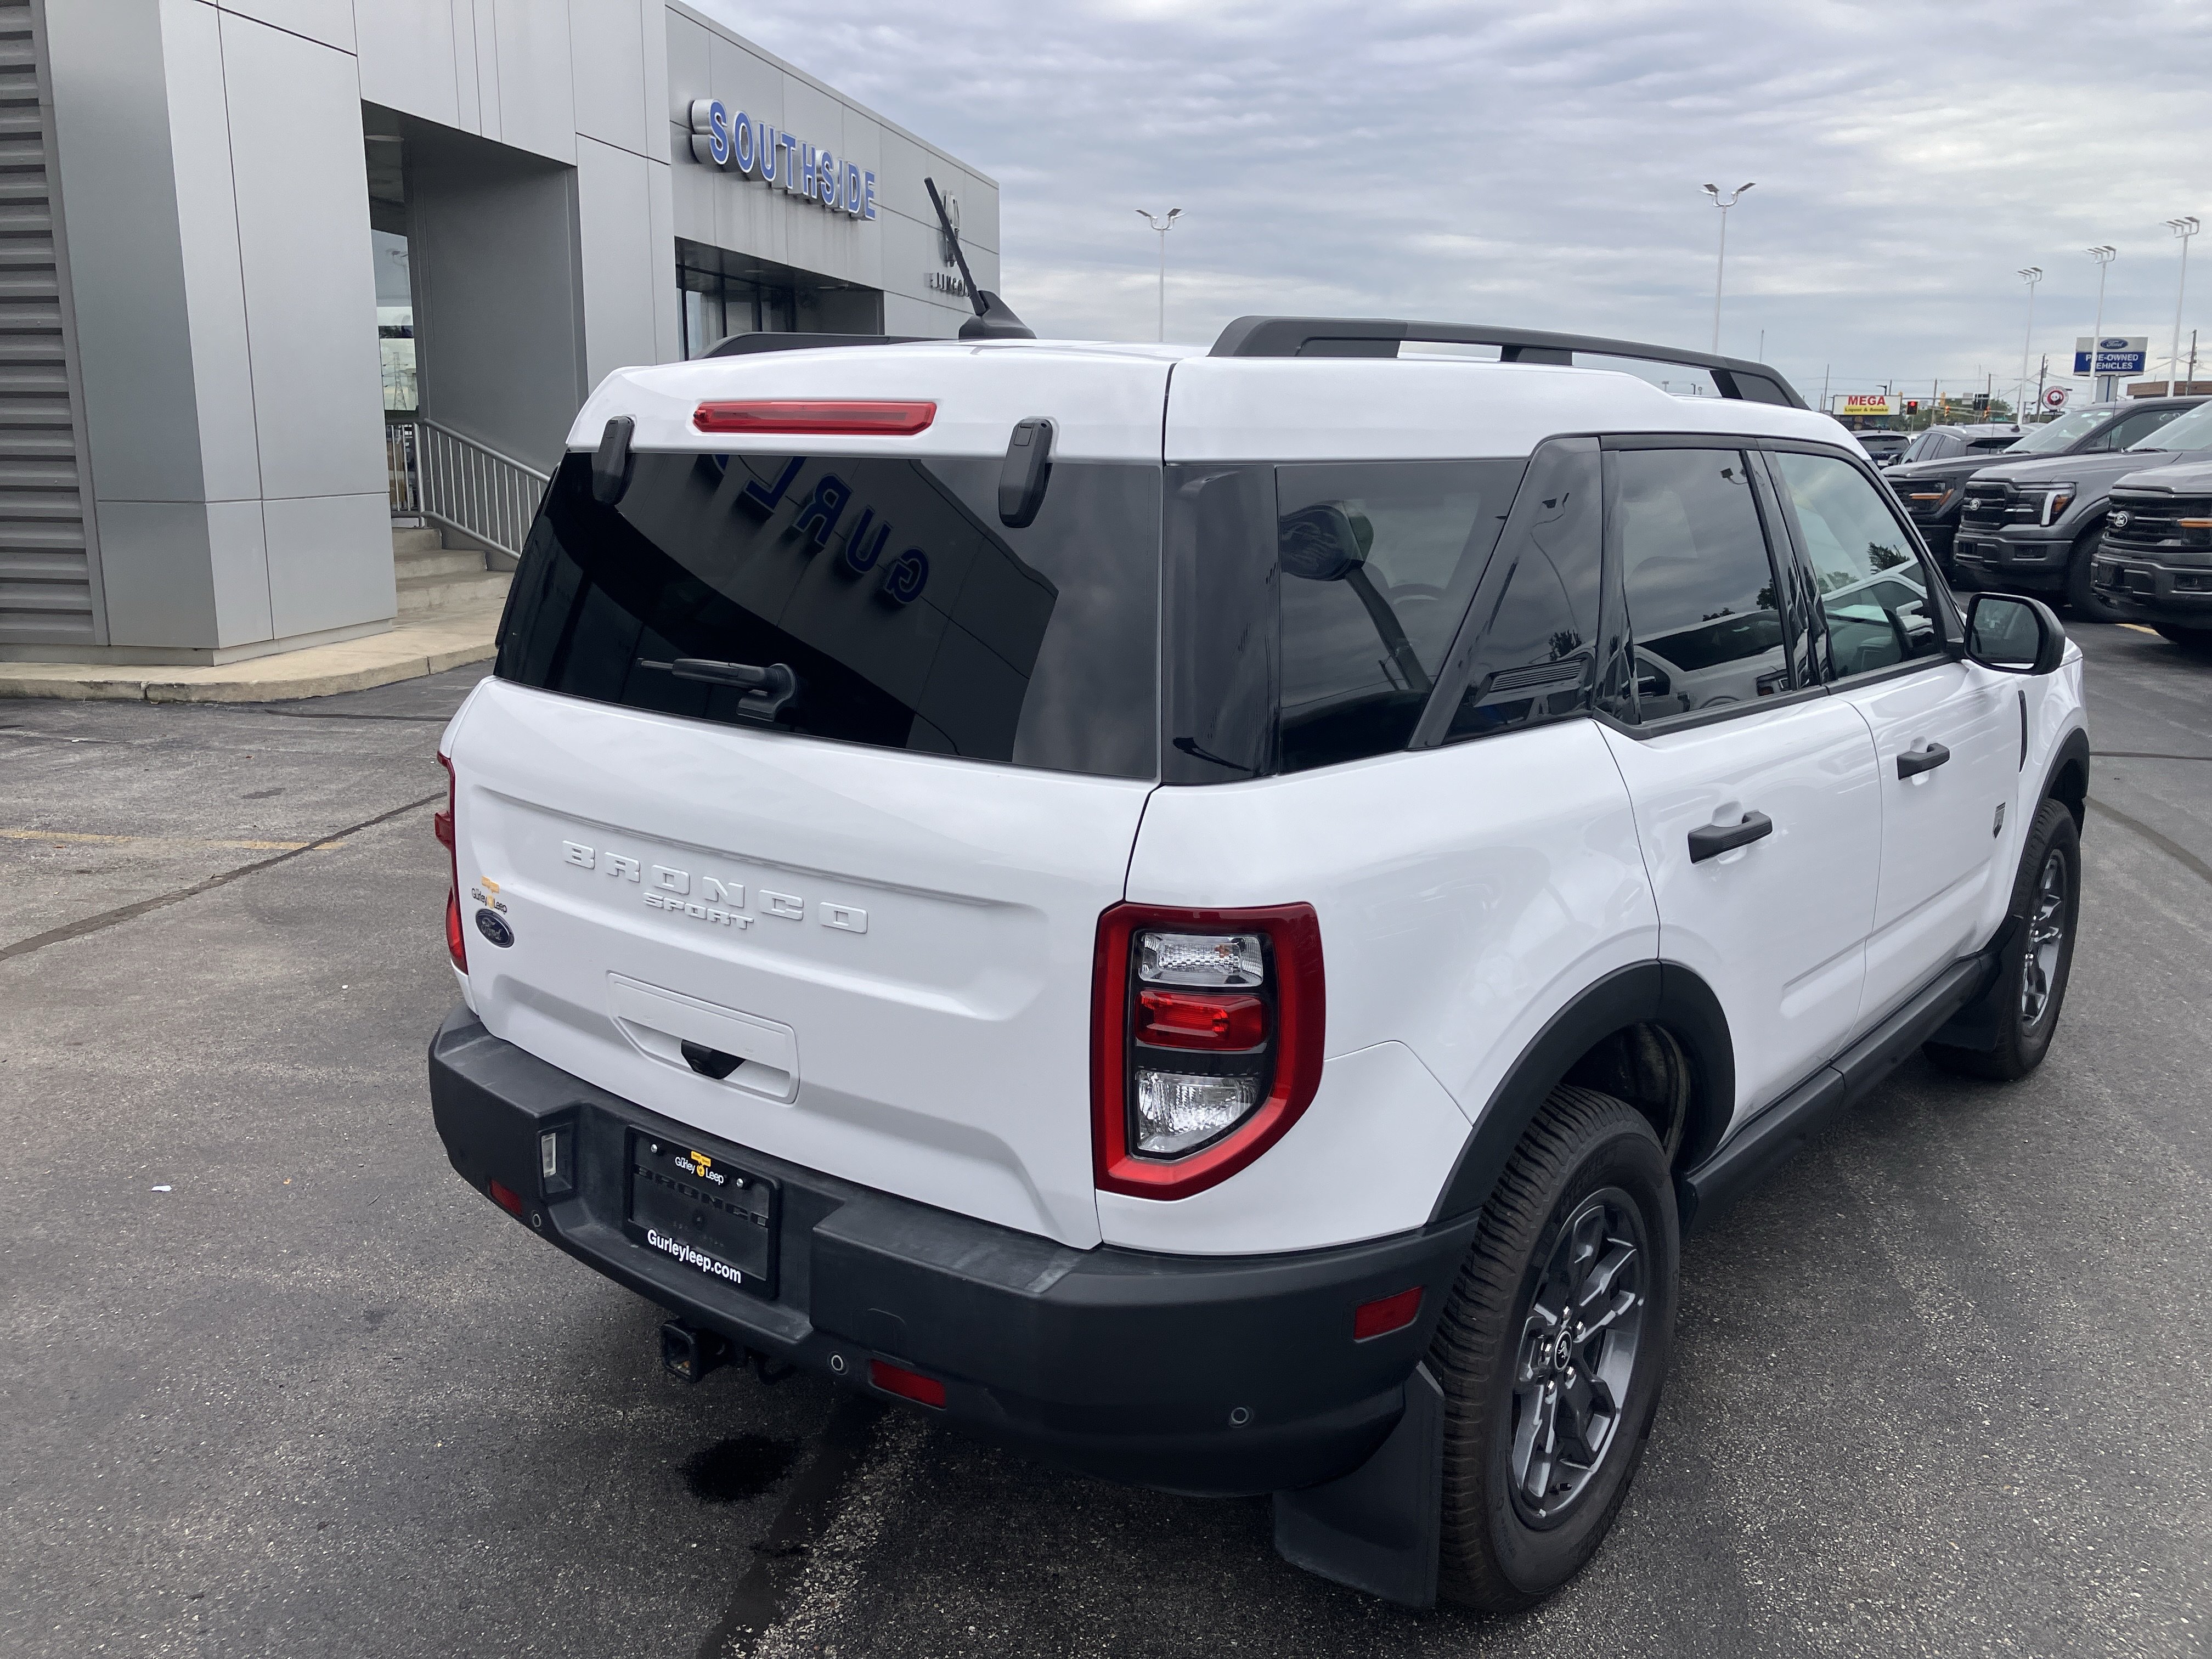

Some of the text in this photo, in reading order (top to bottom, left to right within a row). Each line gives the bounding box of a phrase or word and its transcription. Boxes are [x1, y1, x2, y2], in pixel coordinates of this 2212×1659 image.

[707, 98, 876, 221] SOUTHSIDE
[1847, 394, 1886, 406] MEGA
[562, 839, 868, 934] BRONCO
[493, 898, 507, 915] Leep
[642, 891, 755, 930] SPORT
[675, 1156, 696, 1174] Gurley
[706, 1167, 724, 1186] Leep
[647, 1229, 741, 1284] Gurleyleep.com
